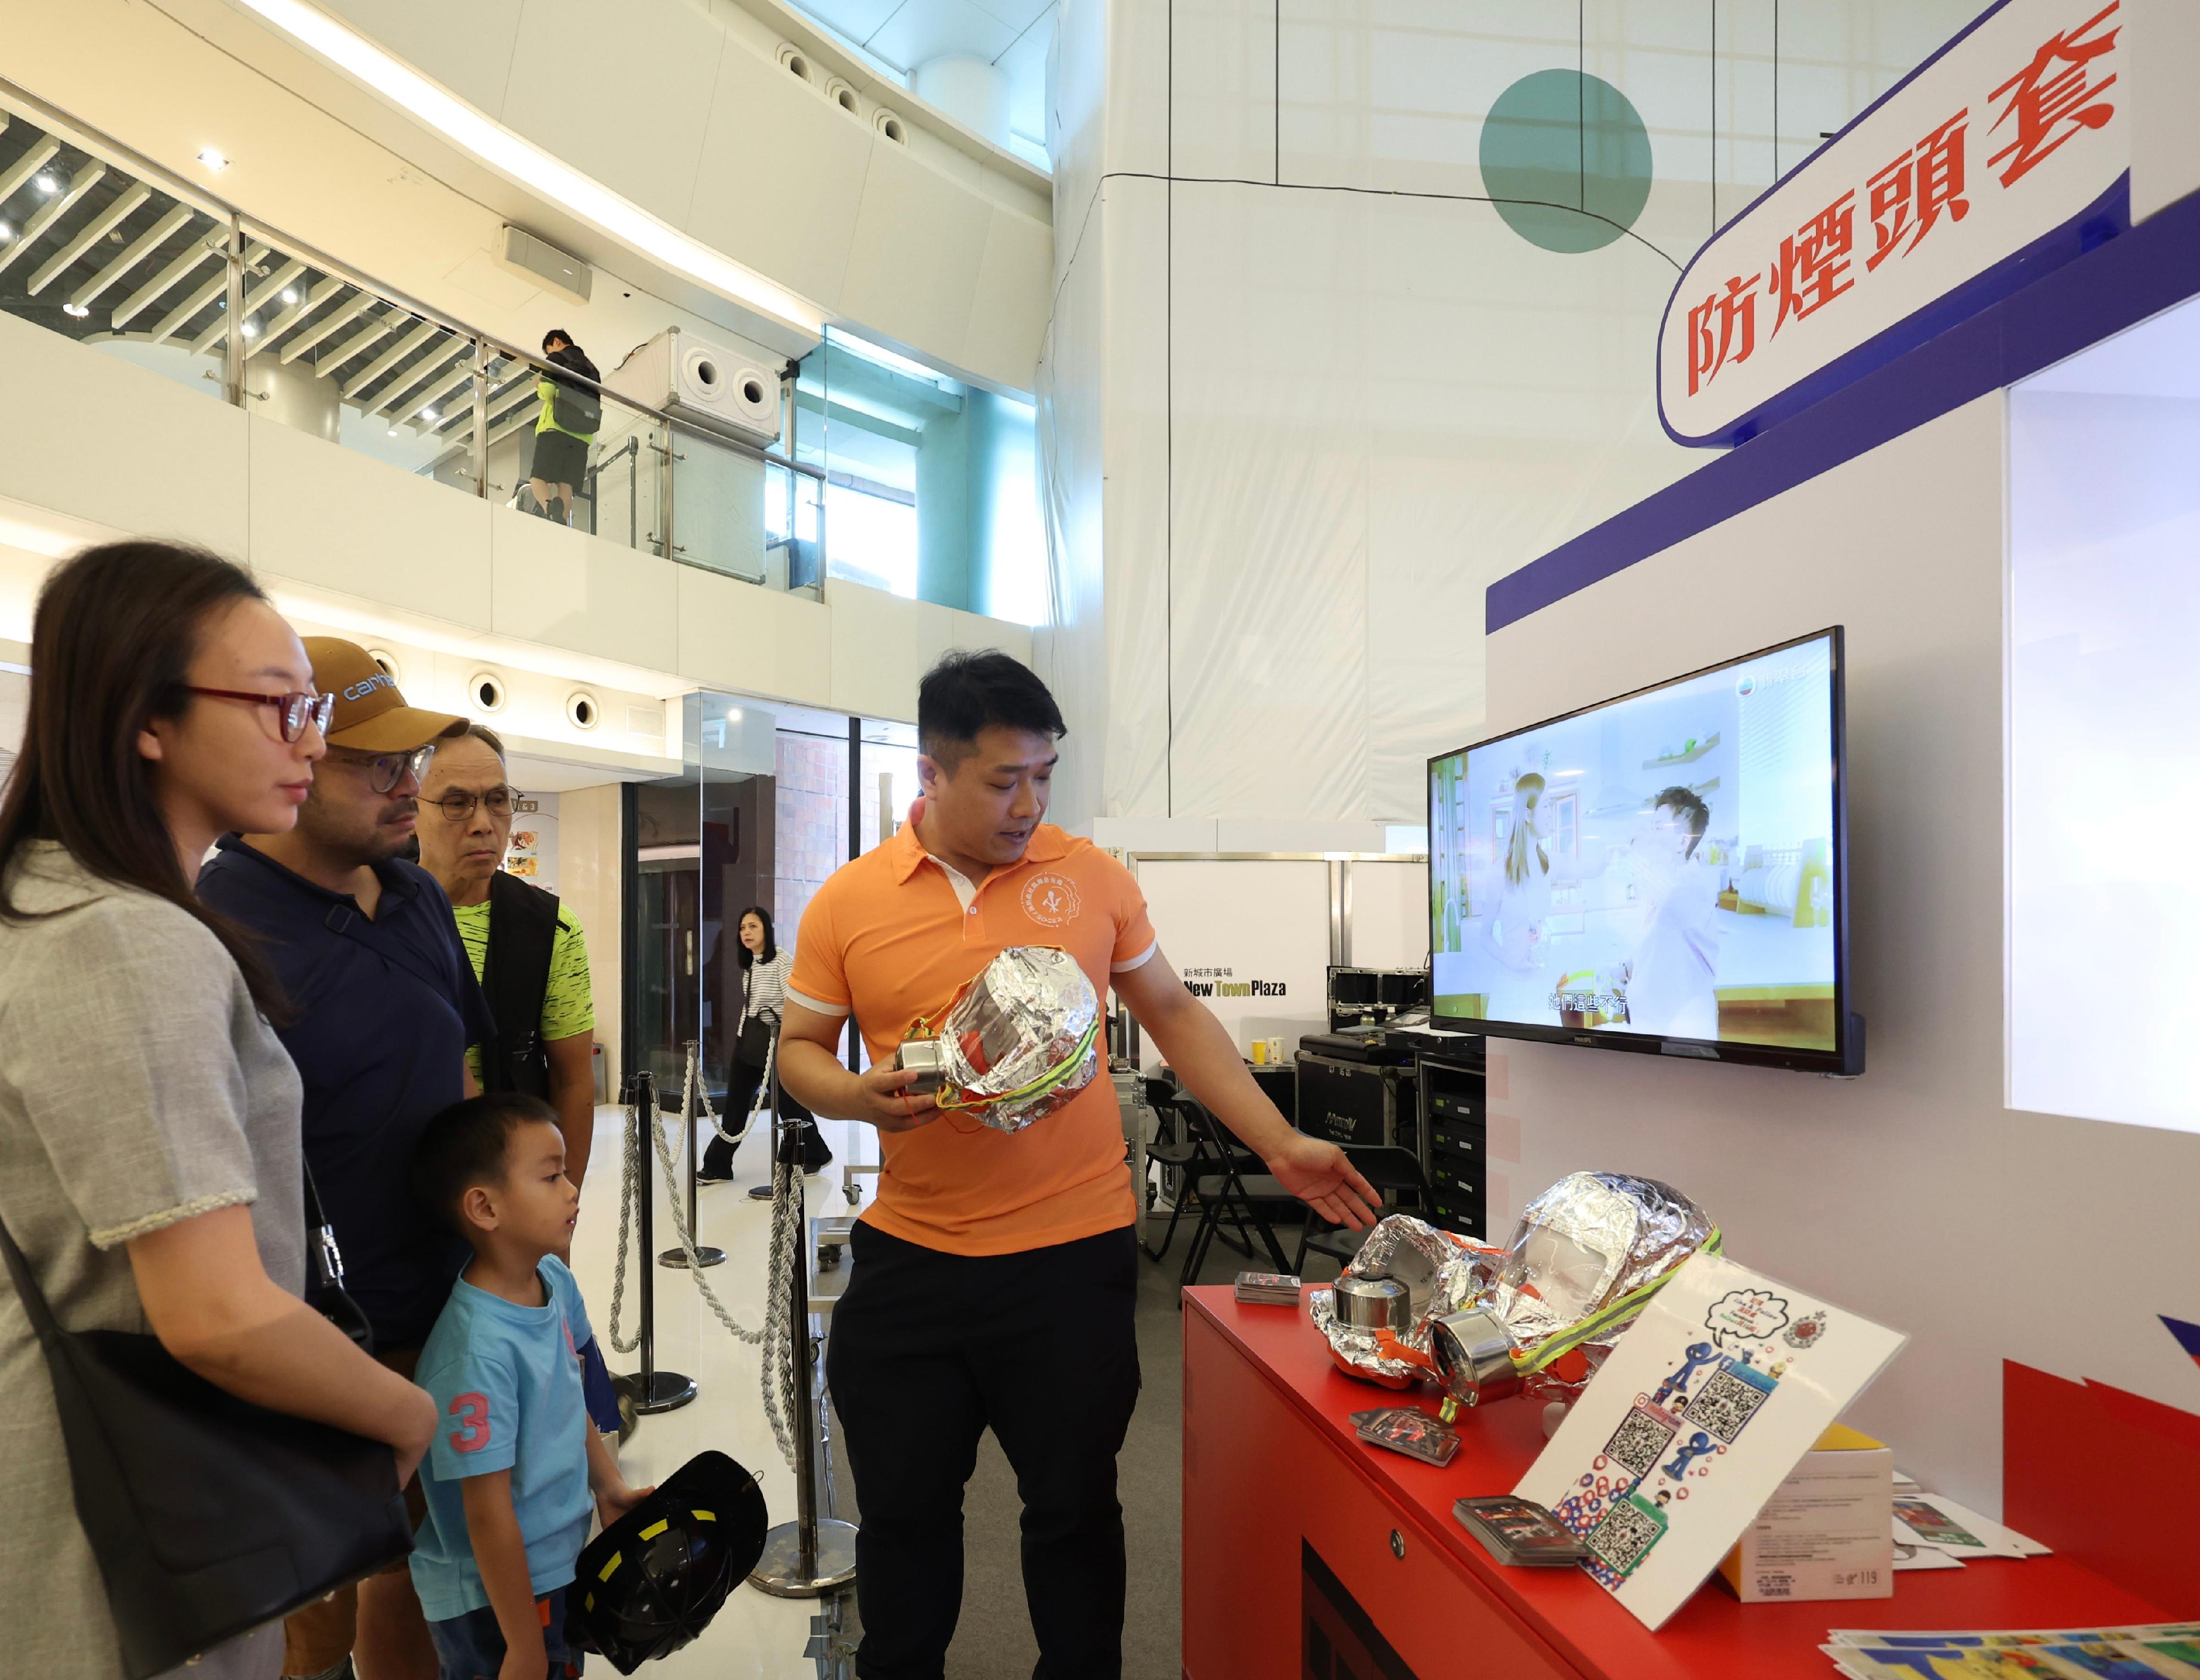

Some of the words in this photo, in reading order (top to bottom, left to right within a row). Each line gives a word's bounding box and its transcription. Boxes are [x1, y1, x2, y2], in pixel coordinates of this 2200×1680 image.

[1688, 1, 2123, 397] 防煙頭套
[1184, 968, 1233, 977] 新城市廣場
[1214, 981, 1250, 996] Town
[1251, 980, 1286, 996] Plaza
[1548, 993, 1627, 1015] 她們這些不行
[449, 1392, 491, 1453] 3
[1861, 1571, 1877, 1584] 119
